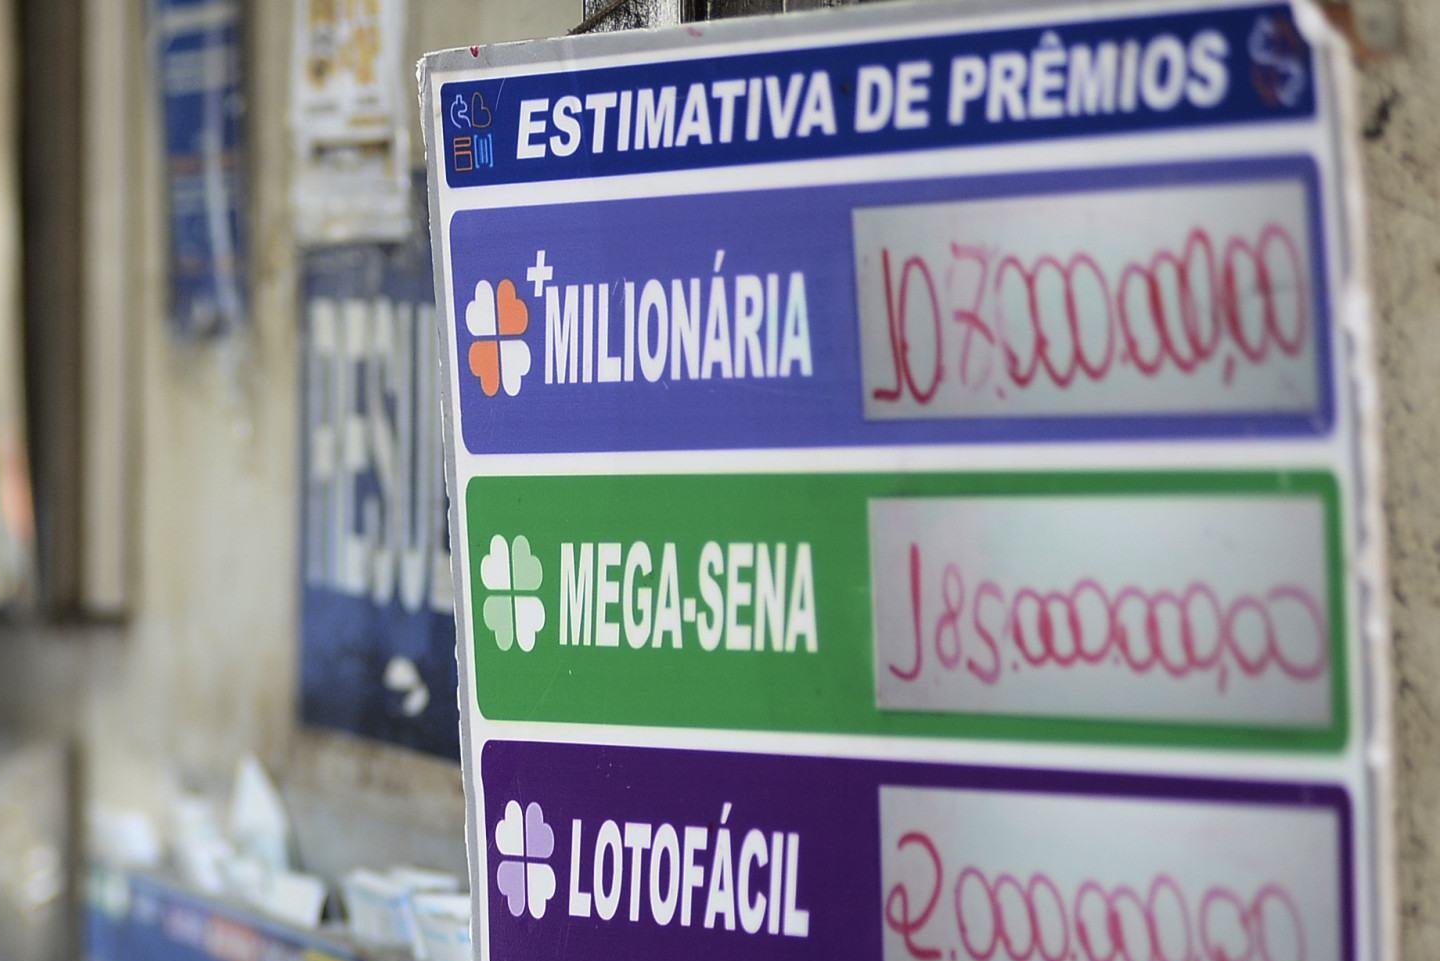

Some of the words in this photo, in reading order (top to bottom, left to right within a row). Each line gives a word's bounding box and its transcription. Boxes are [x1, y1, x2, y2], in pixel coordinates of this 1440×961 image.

[515, 70, 836, 161] ESTIMATIVA
[856, 62, 931, 132] DE
[947, 30, 1230, 127] PRÊMIOS
[559, 541, 818, 652] MEGA-SENA
[569, 802, 810, 937] LOTOFÁCIL
